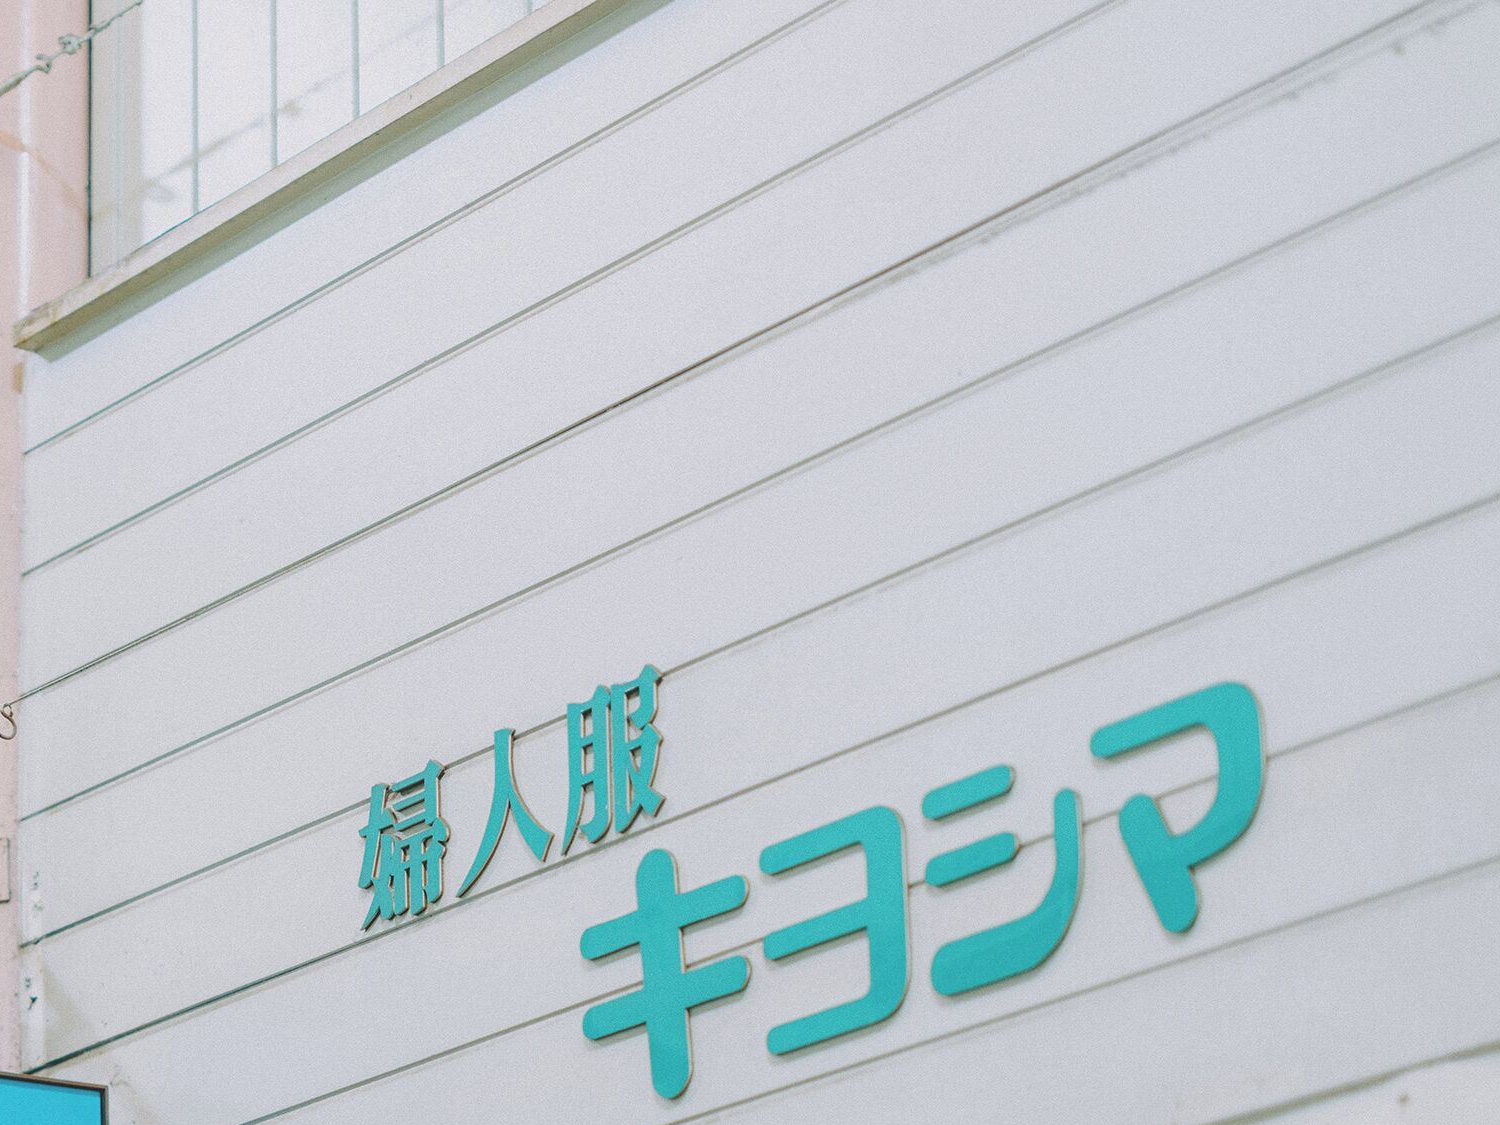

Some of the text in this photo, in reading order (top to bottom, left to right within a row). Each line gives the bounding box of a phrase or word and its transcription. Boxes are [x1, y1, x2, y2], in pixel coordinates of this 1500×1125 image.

[360, 664, 667, 932] 婦人服
[579, 681, 1269, 1100] キヨシマ
